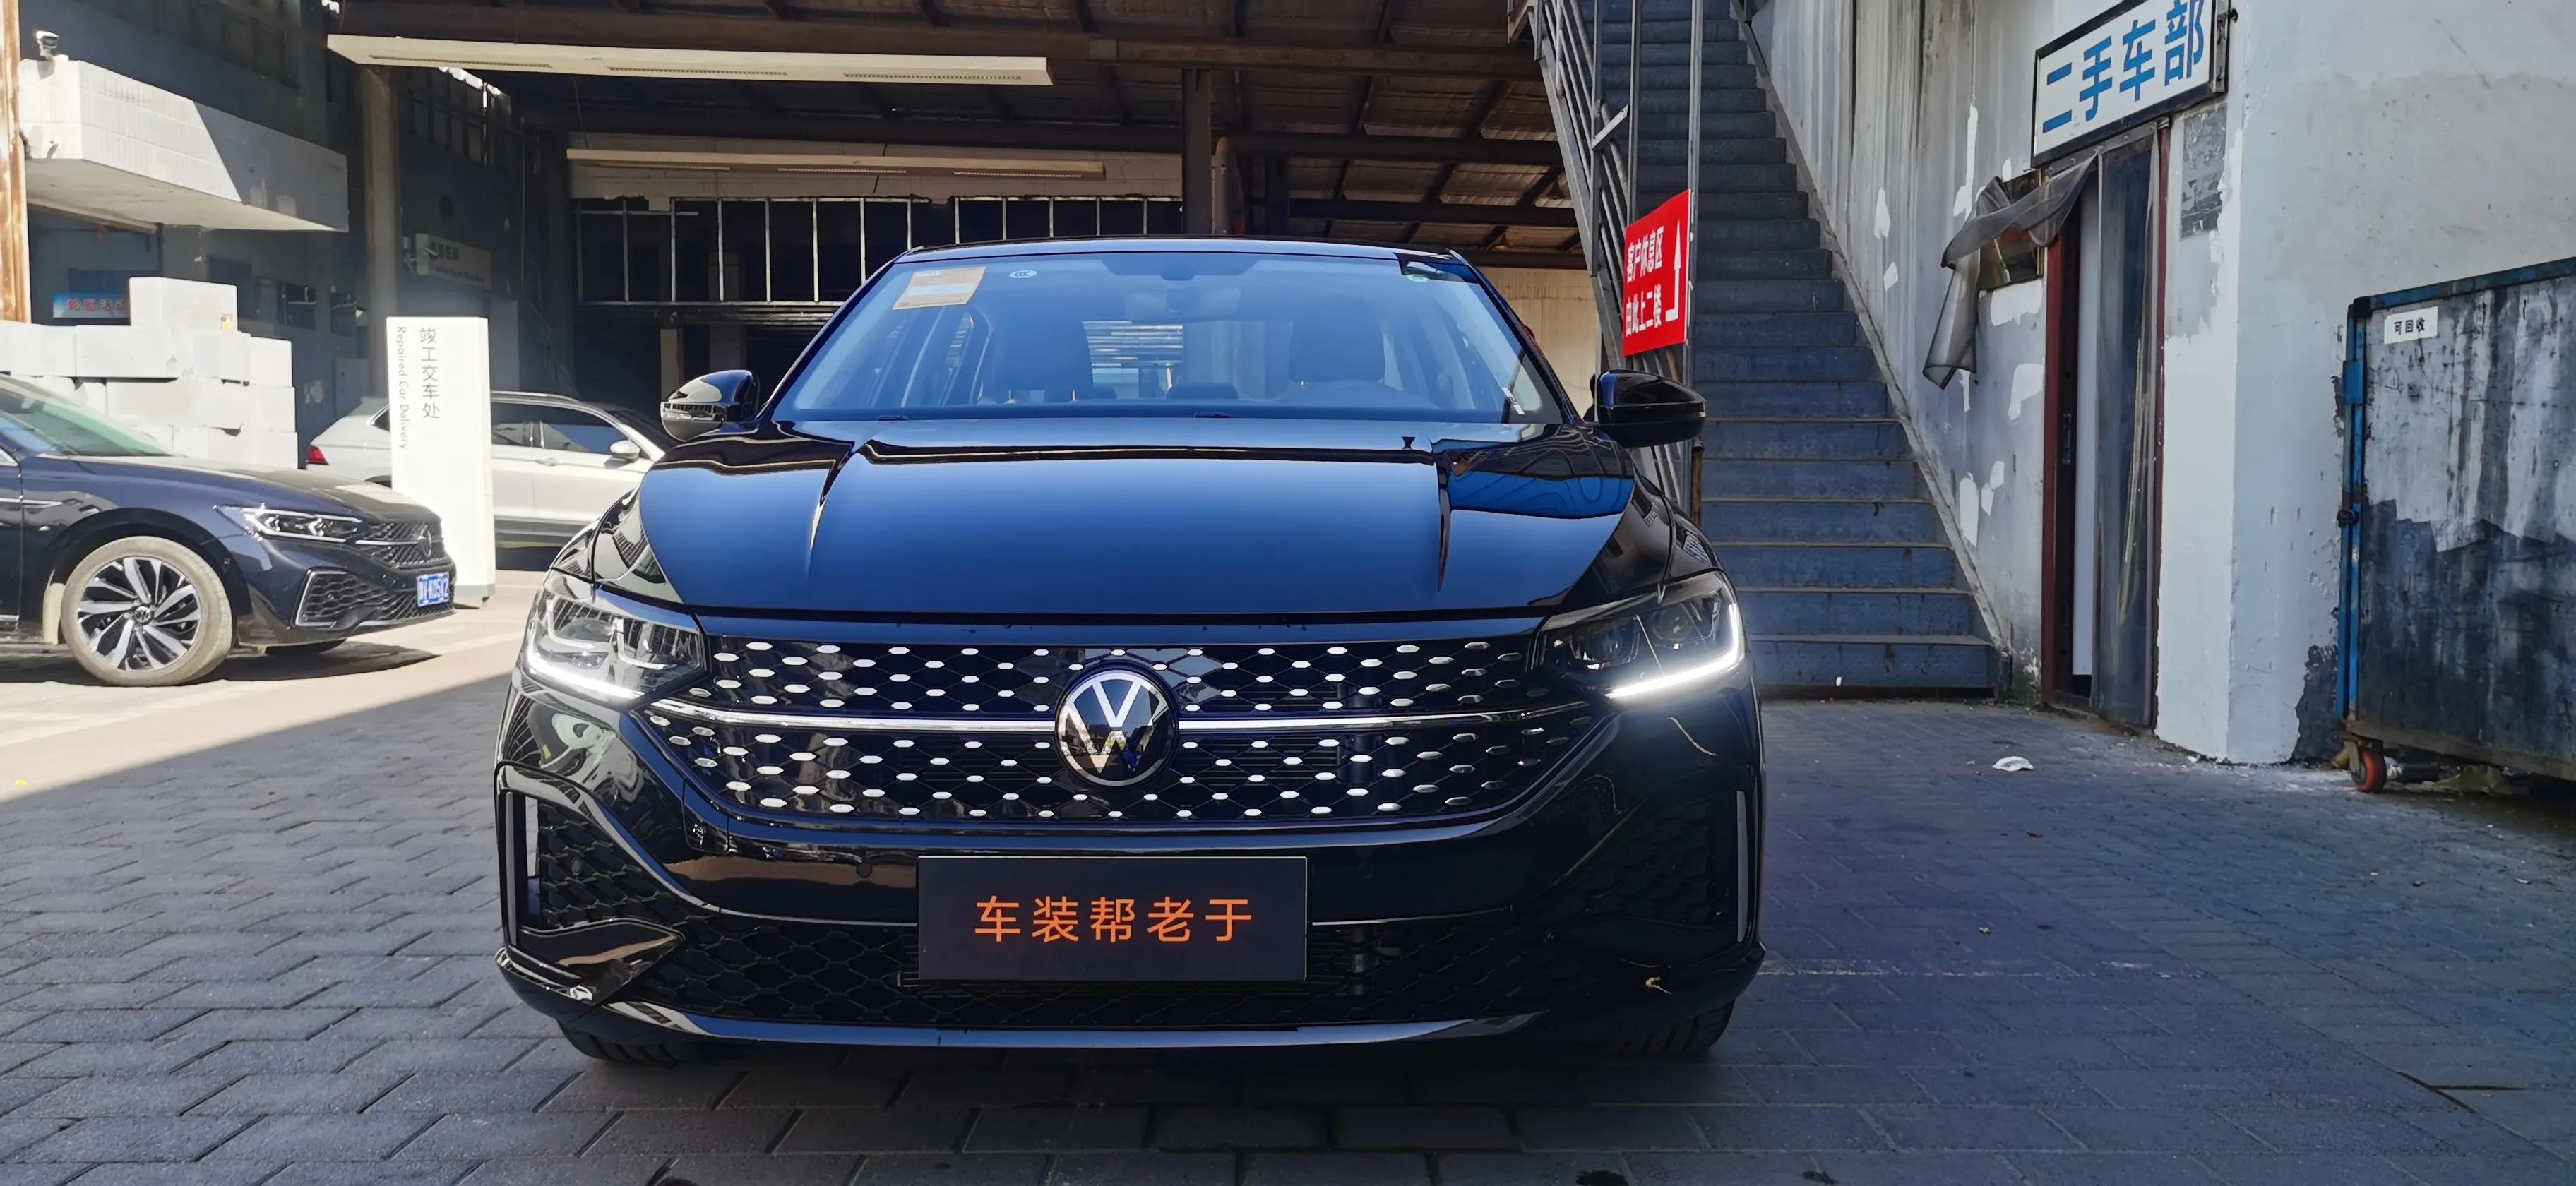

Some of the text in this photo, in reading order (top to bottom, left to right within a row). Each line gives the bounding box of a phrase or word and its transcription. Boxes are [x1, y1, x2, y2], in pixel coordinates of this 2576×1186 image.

[2042, 0, 2204, 133] 二手车部
[1627, 226, 1664, 283] 客户休息区
[2394, 317, 2426, 335] 可回收
[396, 326, 410, 450] Repaired Car Delivery
[419, 327, 440, 419] 竣工交车处
[974, 895, 1252, 943] 车装帮老于
